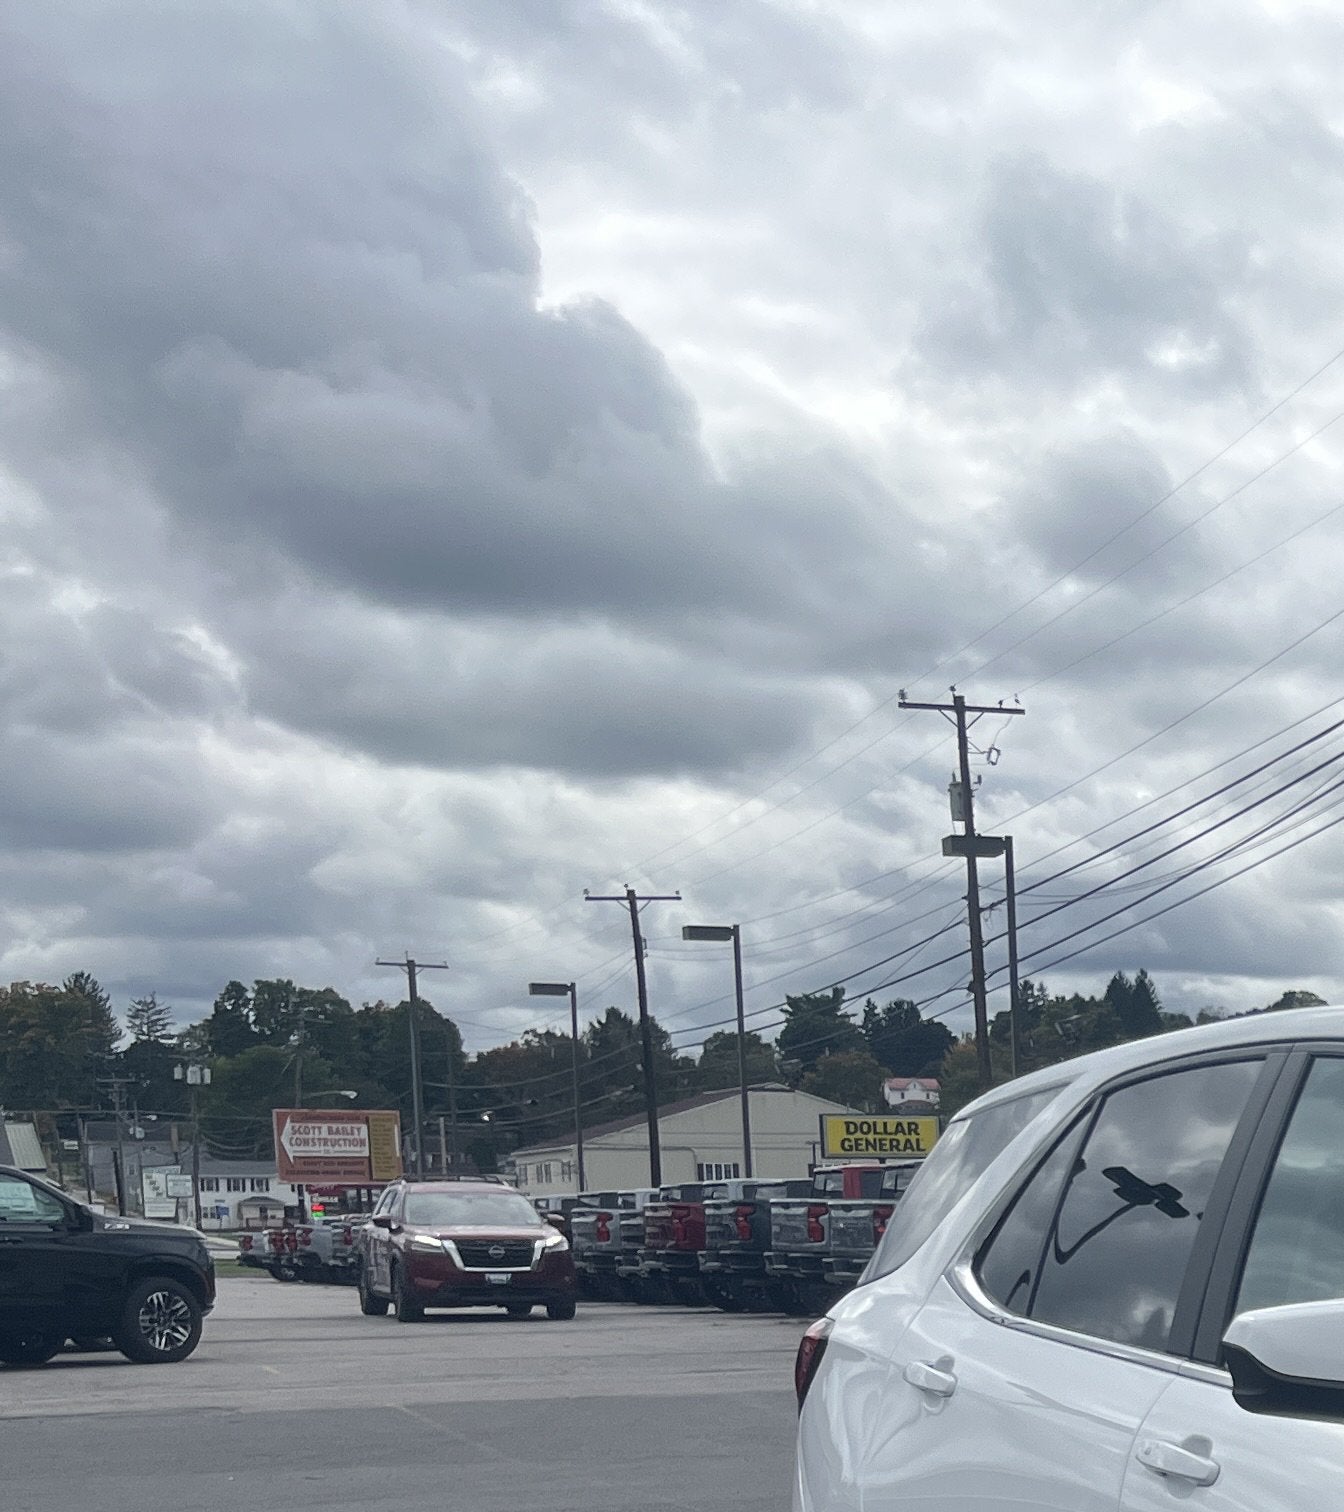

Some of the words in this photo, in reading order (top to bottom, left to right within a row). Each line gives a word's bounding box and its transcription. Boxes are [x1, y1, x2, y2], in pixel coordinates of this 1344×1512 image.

[291, 1125, 322, 1136] SCOTT
[844, 1121, 920, 1136] DOLLAR
[289, 1136, 366, 1148] CONSTRUCTION
[841, 1138, 926, 1153] GENERAL
